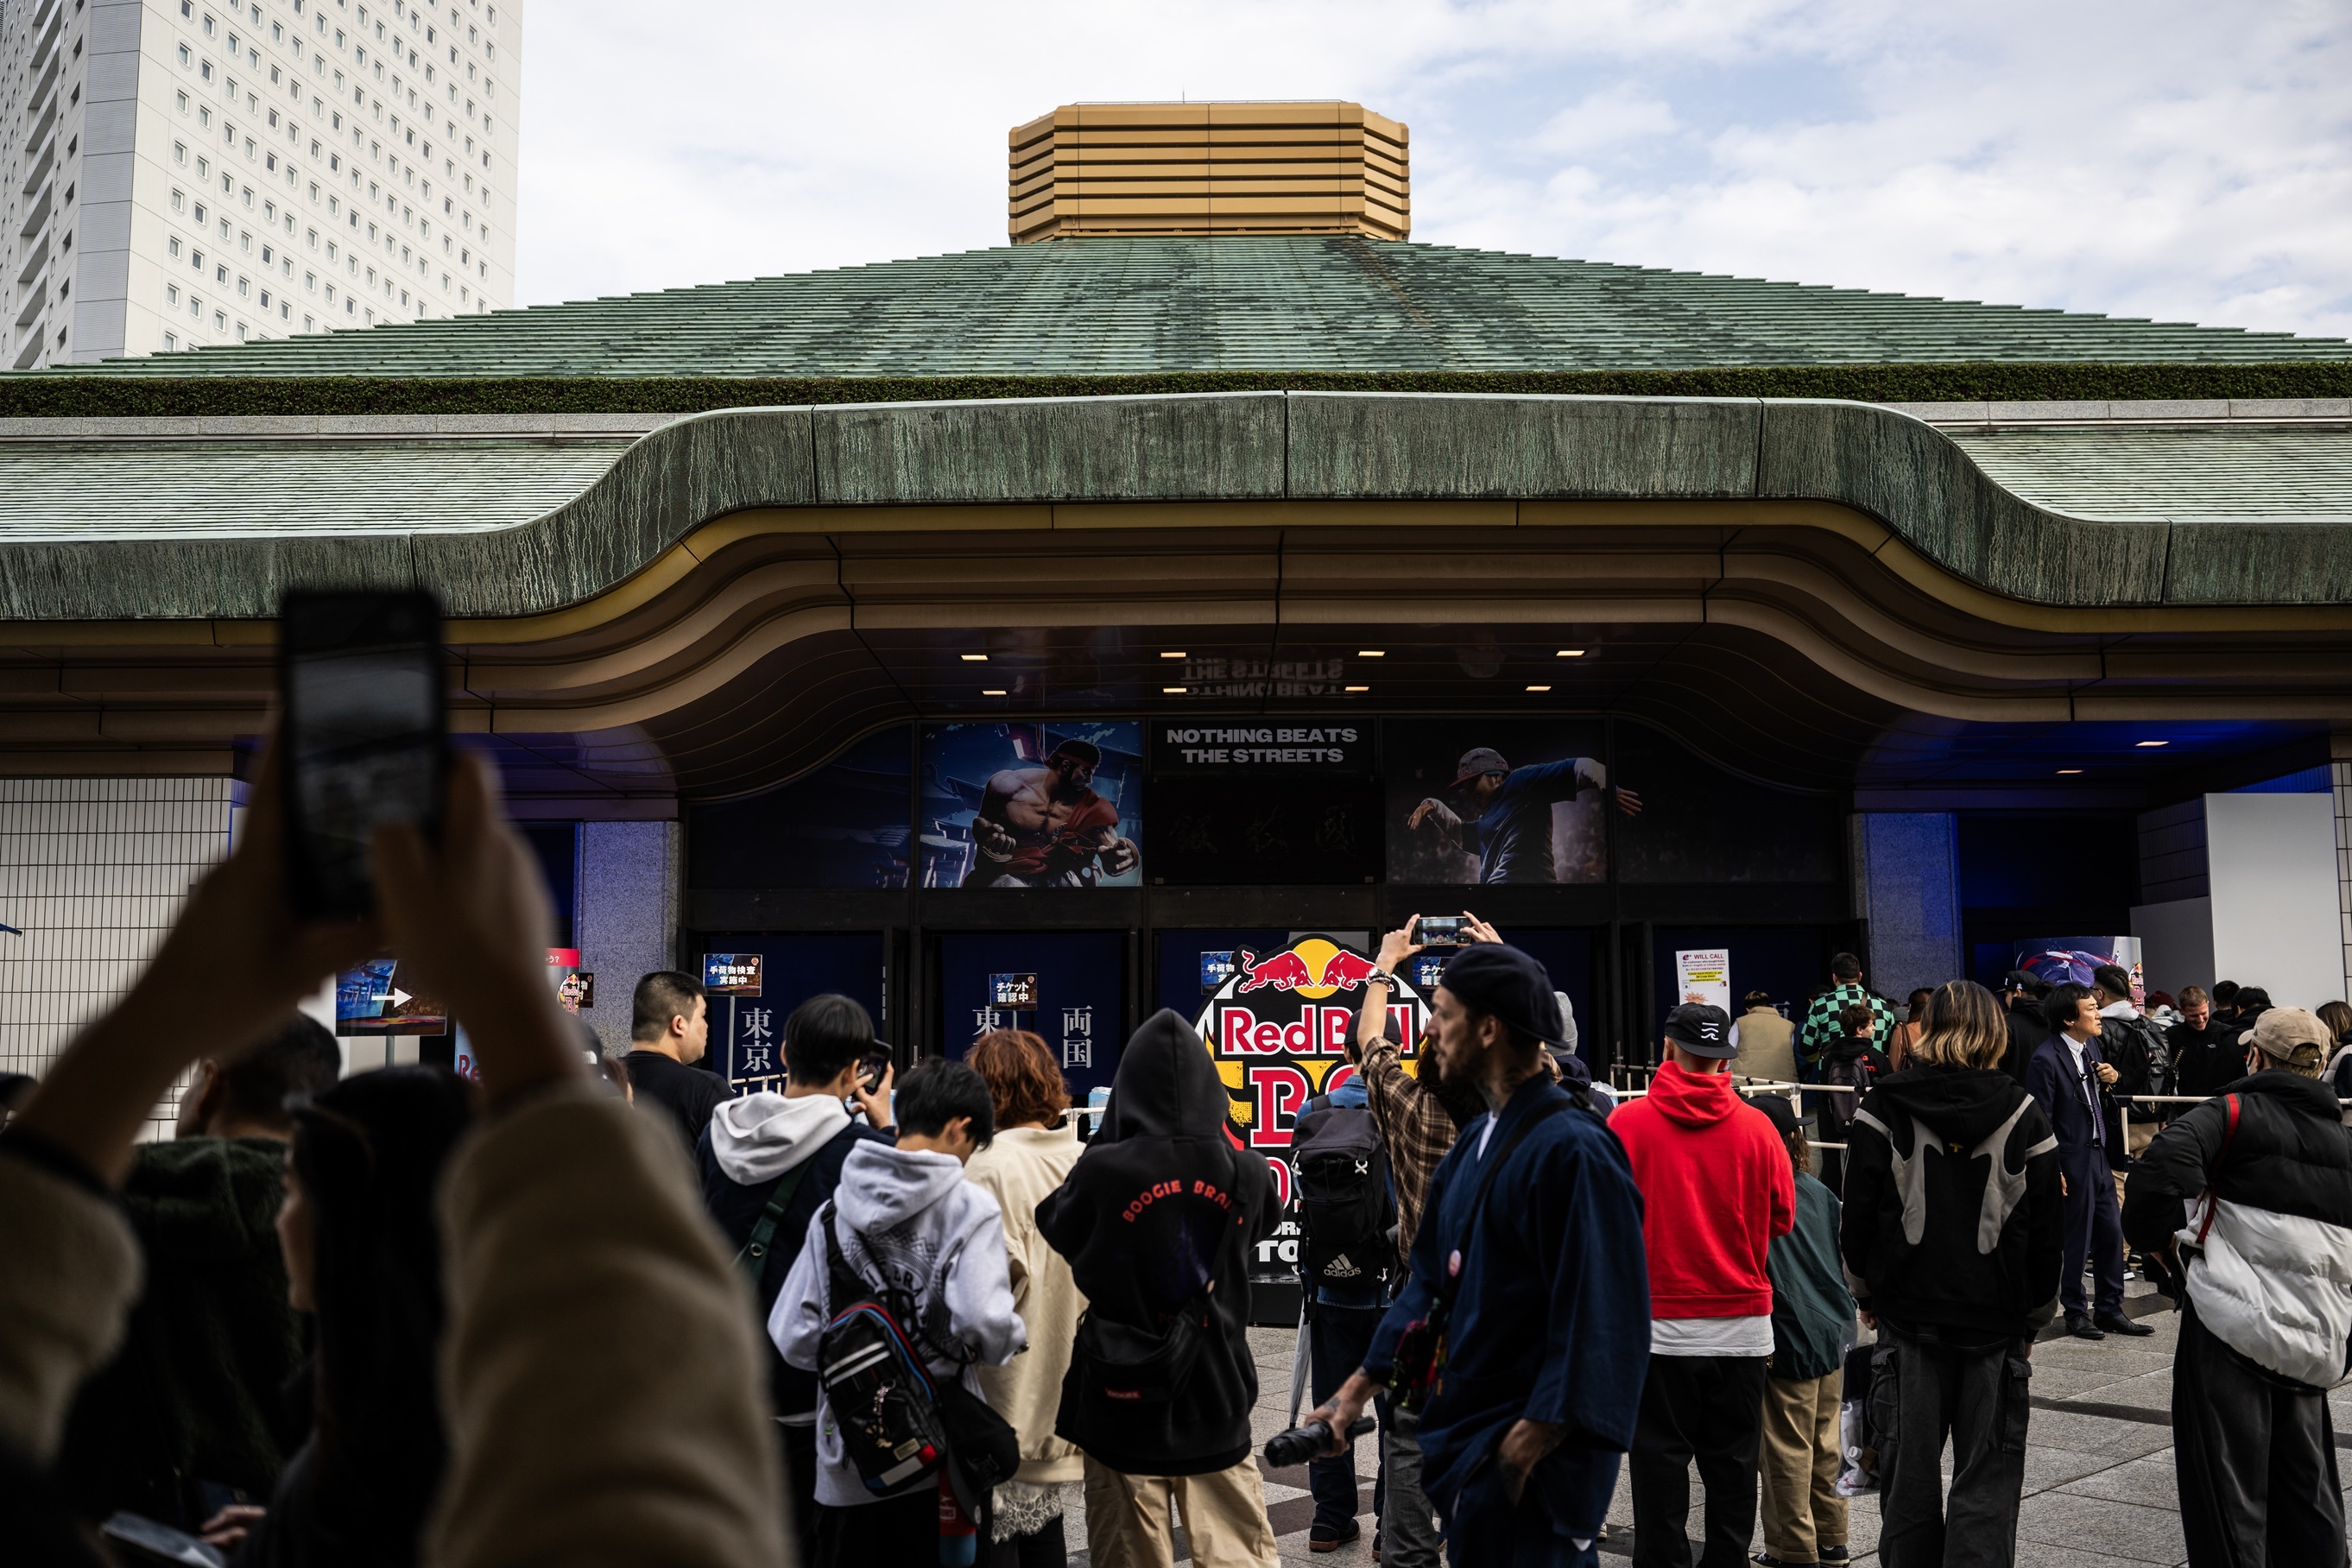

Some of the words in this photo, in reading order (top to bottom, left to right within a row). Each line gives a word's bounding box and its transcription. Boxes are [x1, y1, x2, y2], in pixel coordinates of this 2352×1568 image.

[1167, 729, 1273, 743] NOTHING
[1277, 728, 1358, 743] BEATS
[1181, 749, 1230, 763] THE
[1233, 749, 1344, 763] STREETS
[710, 965, 756, 975] 手荷物検査
[719, 976, 748, 985] 実施中
[996, 982, 1029, 992] チケット
[996, 992, 1029, 1002] 確認中
[1223, 1006, 1314, 1053] Red
[742, 1007, 774, 1072] 東京
[1062, 1005, 1093, 1070] 両国
[1122, 1179, 1183, 1223] BOOGIE
[1324, 1266, 1362, 1278] adidas
